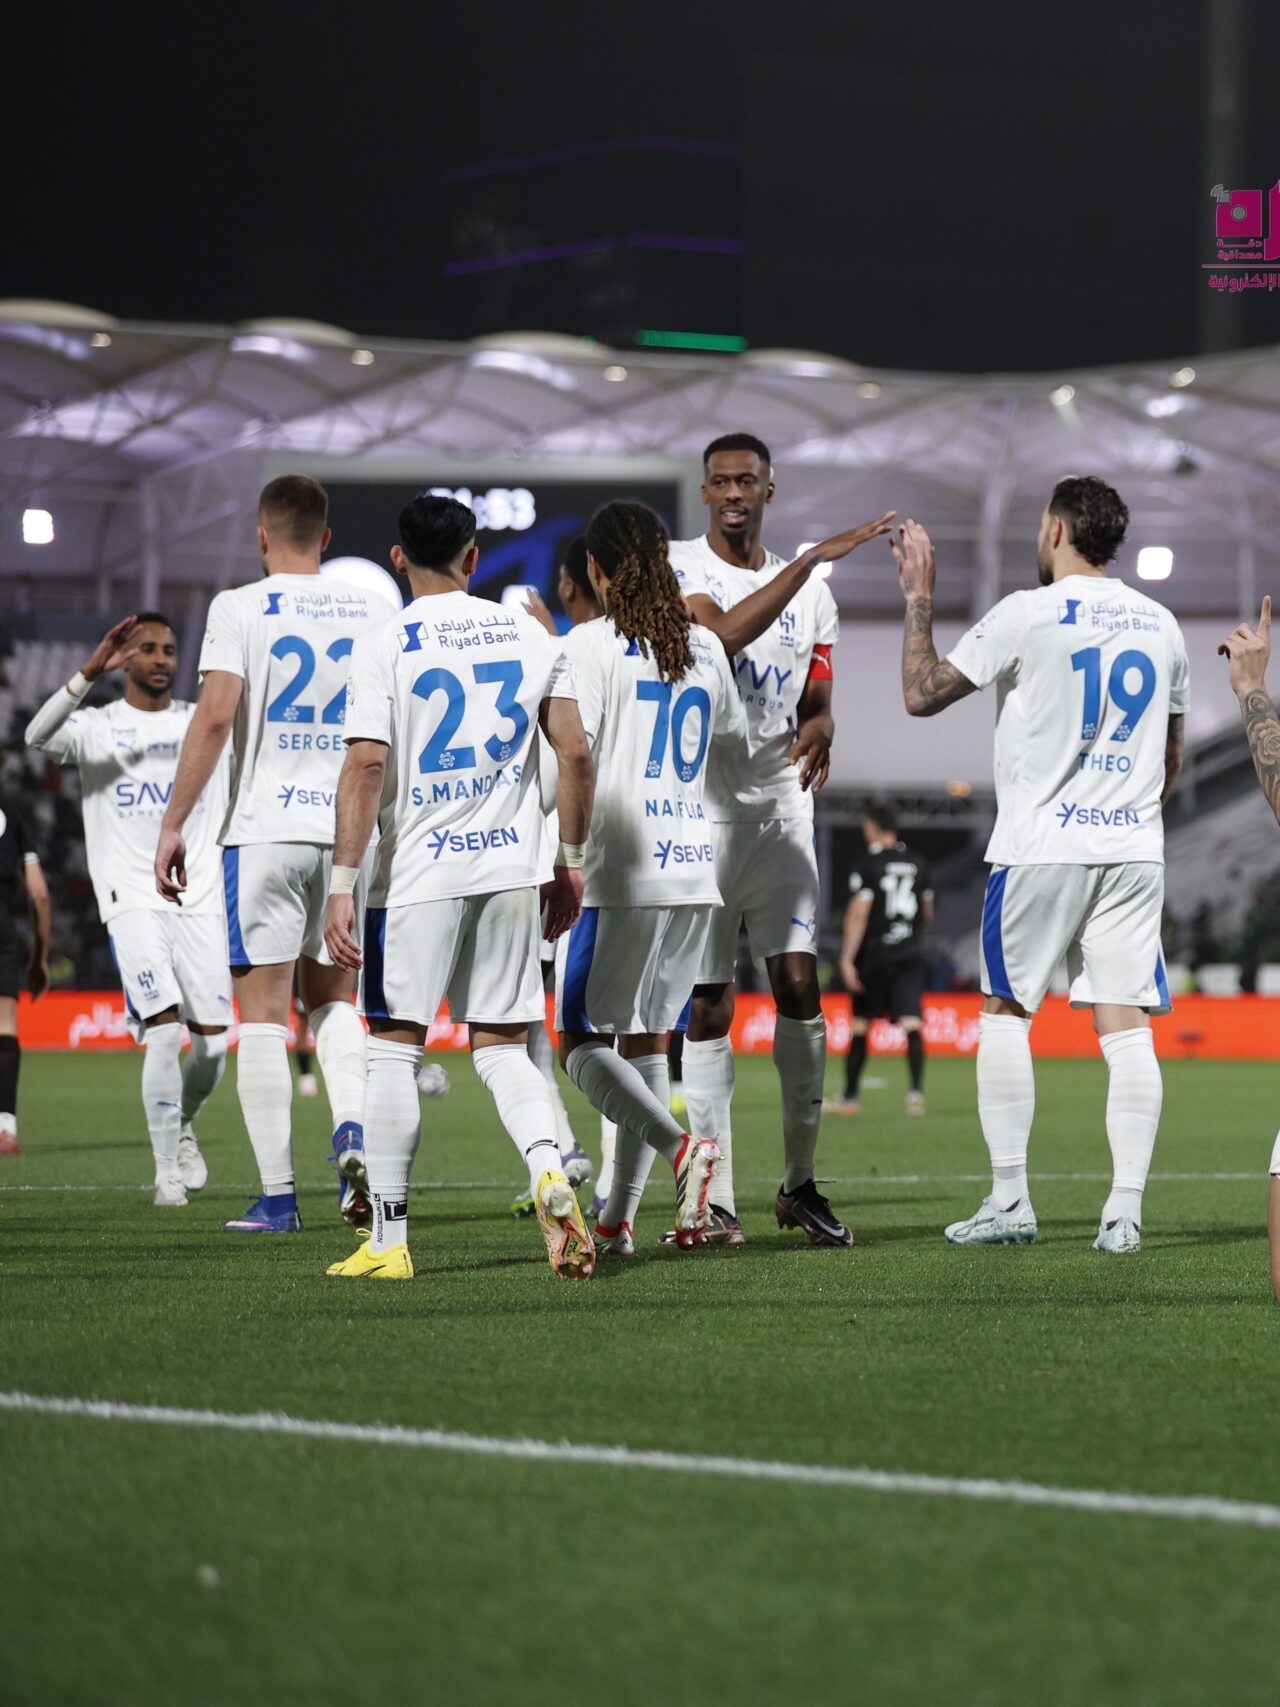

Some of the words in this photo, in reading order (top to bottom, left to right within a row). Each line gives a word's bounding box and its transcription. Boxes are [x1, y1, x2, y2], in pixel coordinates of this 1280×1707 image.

[296, 606, 335, 620] Riyad
[338, 607, 369, 619] Bank
[1091, 617, 1130, 632] Riyad
[1132, 618, 1162, 632] Bank
[438, 633, 481, 650] Riyad
[485, 631, 520, 645] Bank
[1070, 646, 1157, 742] 19
[411, 660, 529, 774] 23
[636, 679, 712, 783] 70
[278, 733, 348, 751] SERGE
[1078, 752, 1131, 773] THEO
